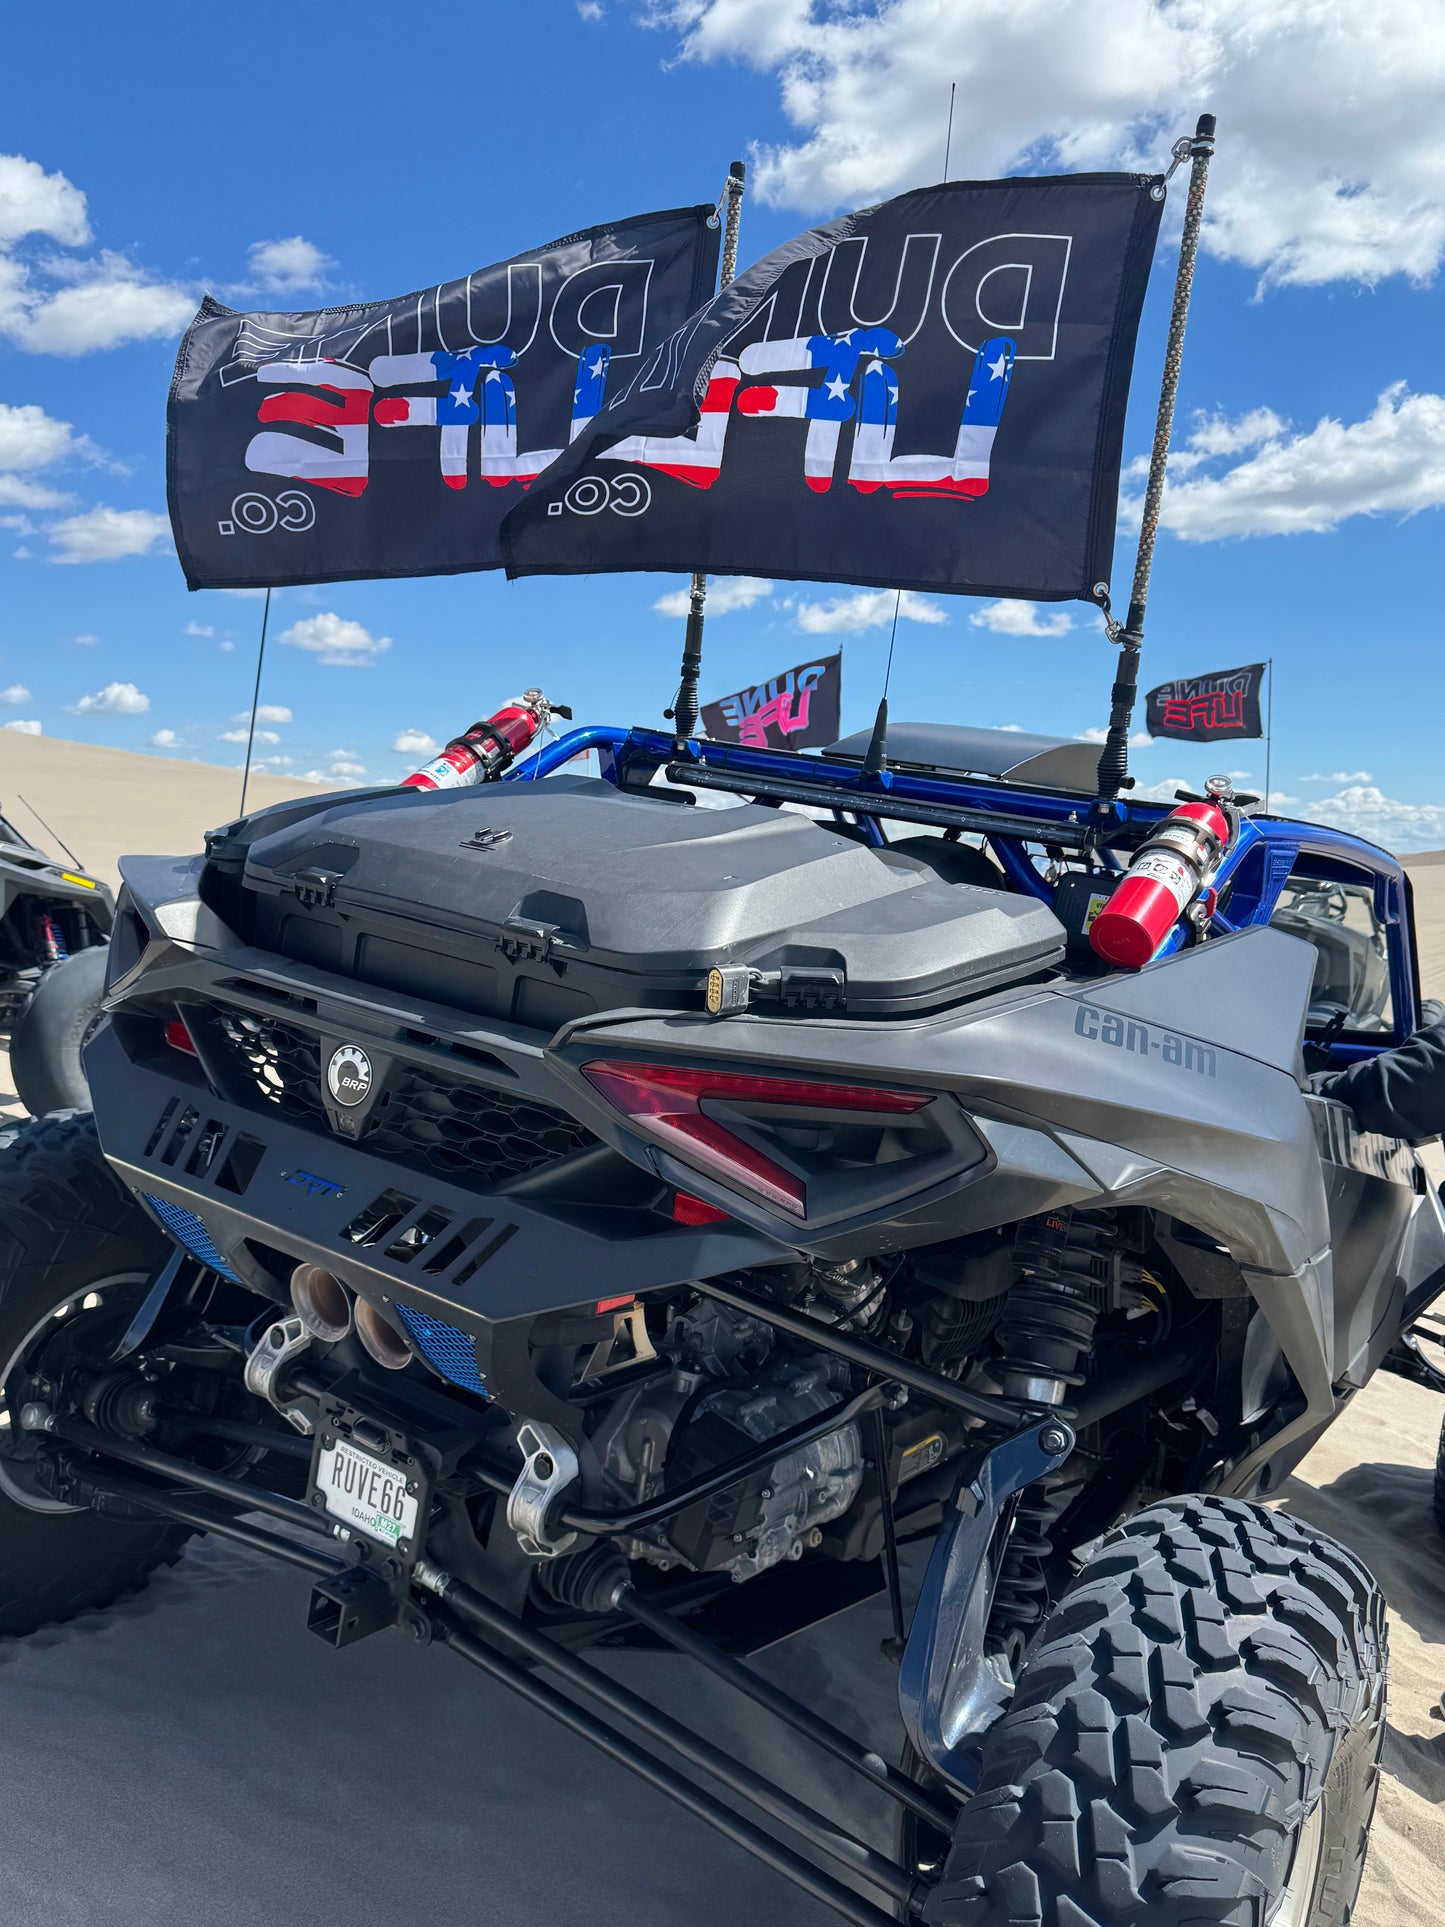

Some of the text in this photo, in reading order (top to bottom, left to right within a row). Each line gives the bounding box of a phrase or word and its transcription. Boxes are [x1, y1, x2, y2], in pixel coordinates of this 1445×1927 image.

[1074, 1005, 1216, 1078] can-am
[341, 1076, 368, 1092] BRP
[340, 1445, 404, 1484] RESTRICTED VEHICLE
[331, 1451, 406, 1521] RUVE66
[351, 1506, 378, 1527] IDAHO
